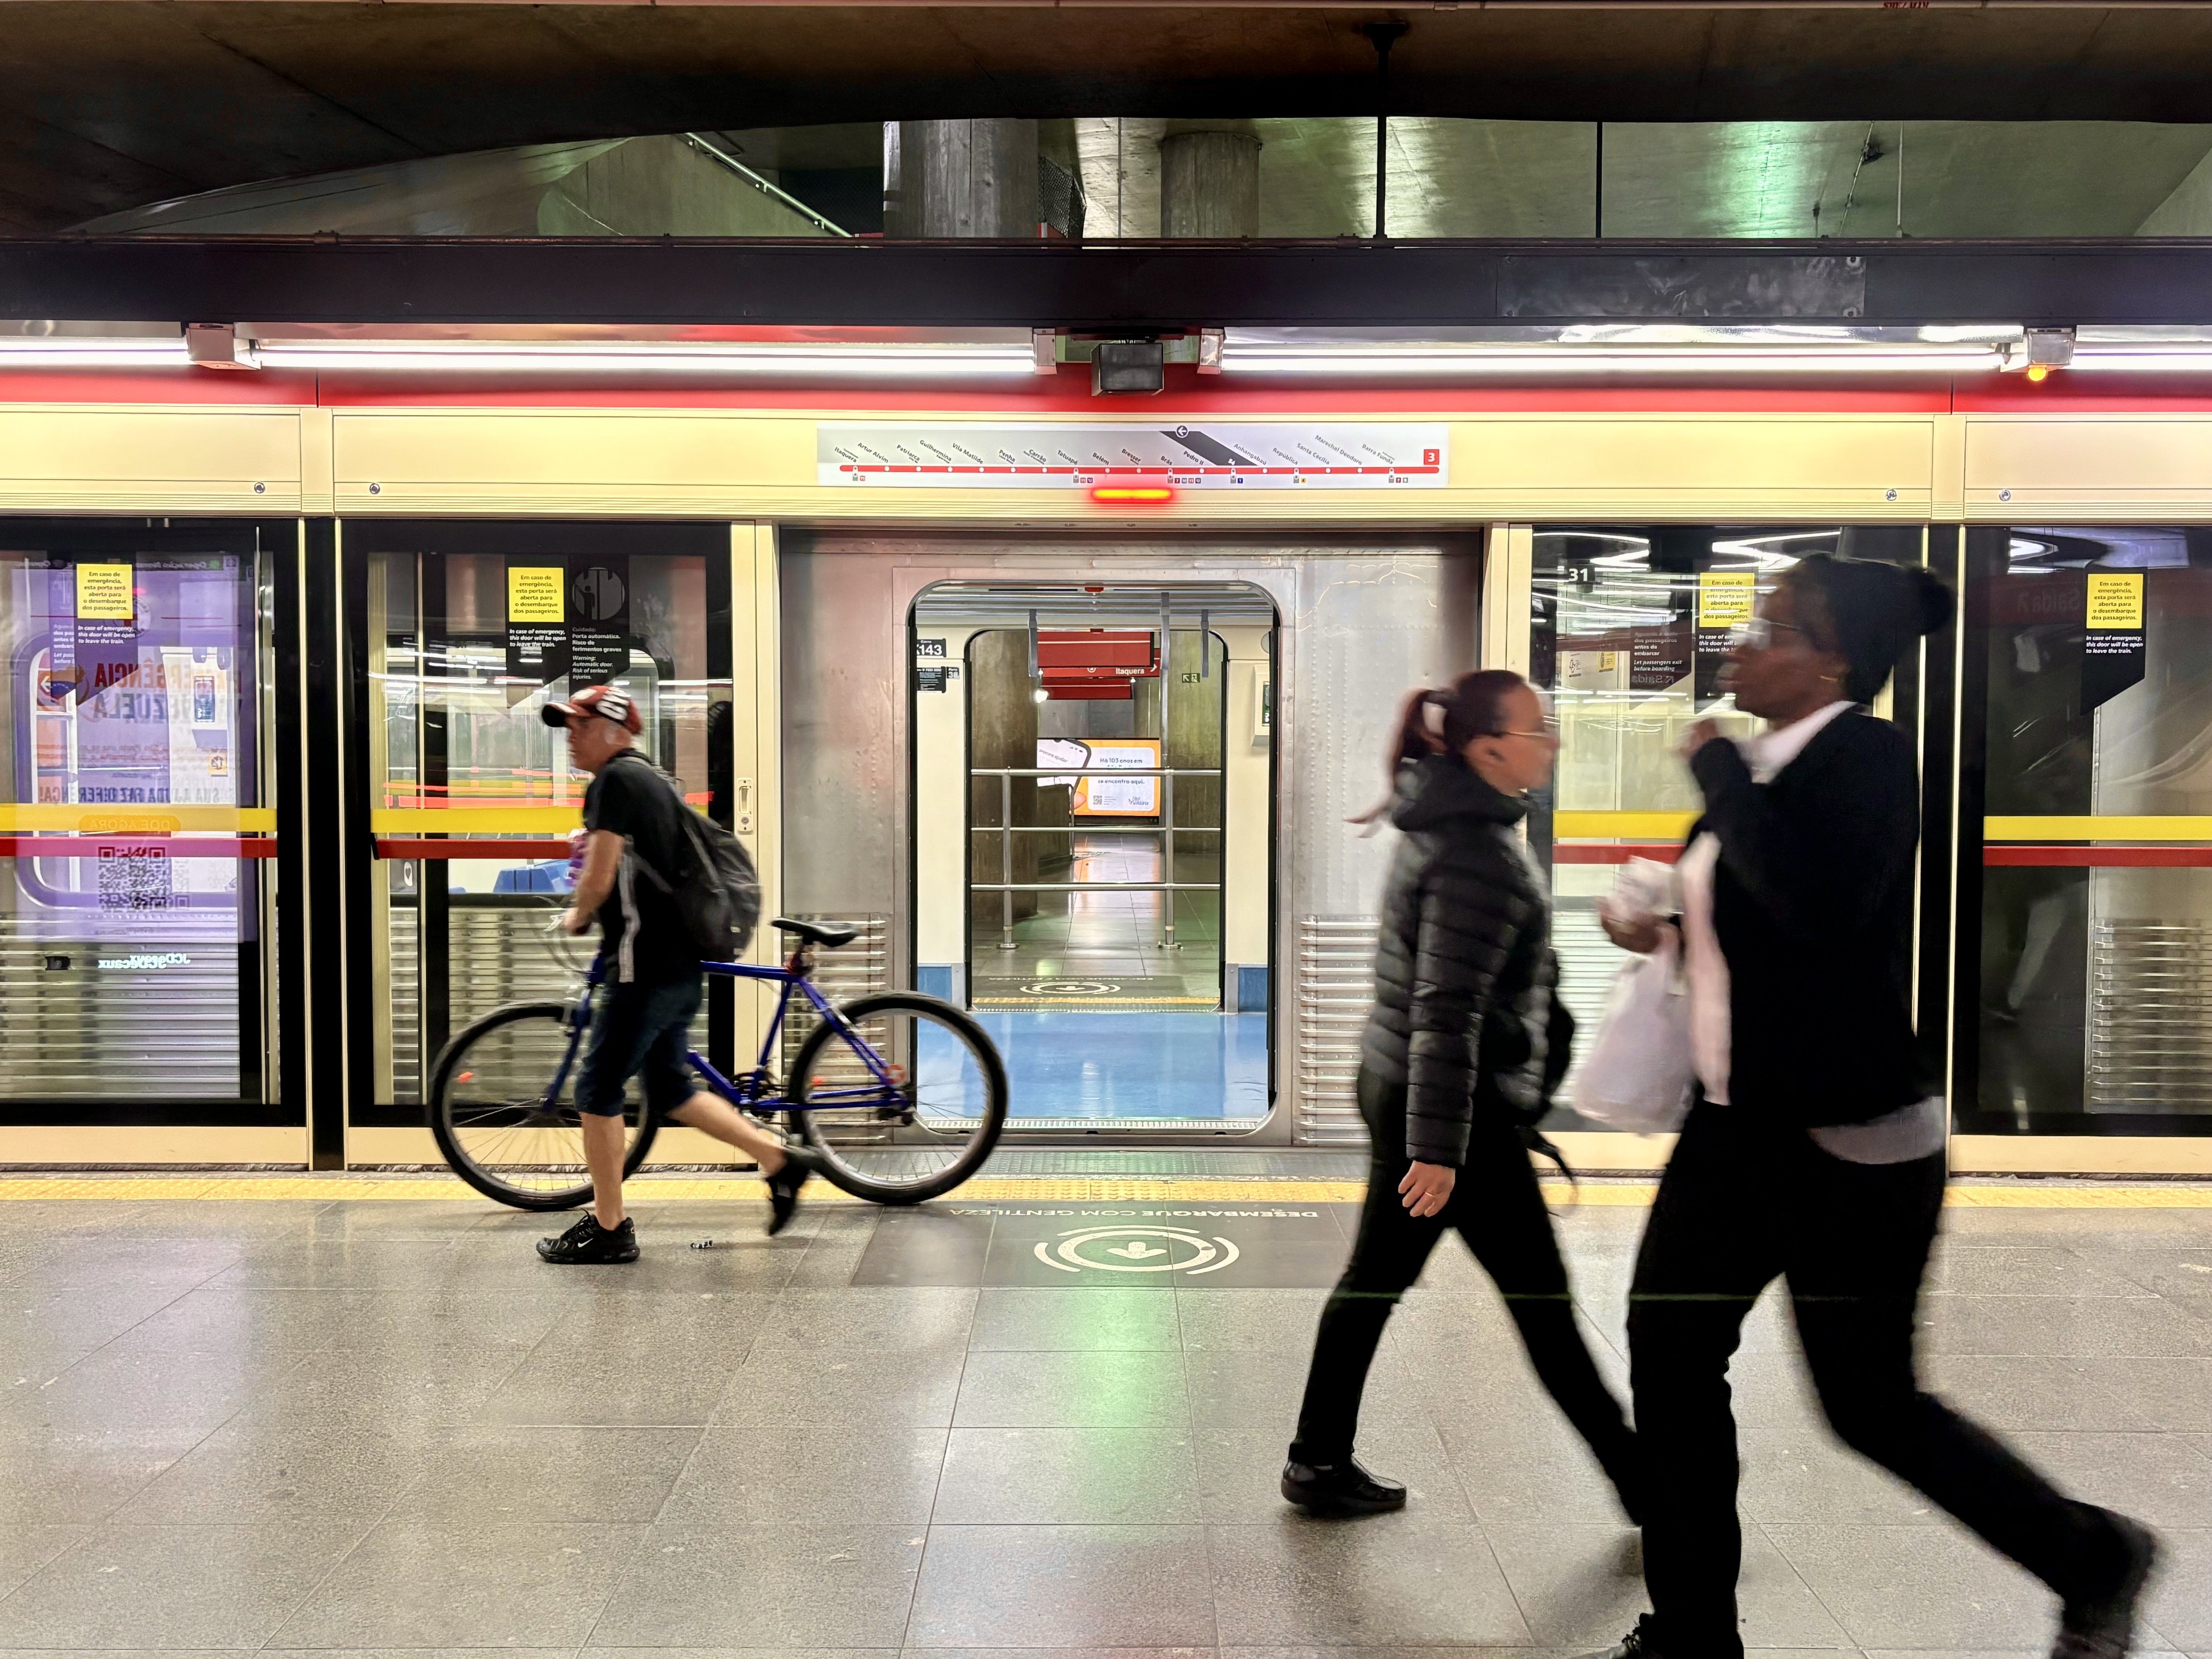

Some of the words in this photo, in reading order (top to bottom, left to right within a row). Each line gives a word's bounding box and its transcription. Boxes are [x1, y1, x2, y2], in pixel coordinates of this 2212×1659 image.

[835, 447, 857, 463] Itaquera
[858, 443, 872, 453] Artur
[872, 452, 888, 463] Alvim
[897, 445, 920, 461] Patriarca
[920, 440, 951, 461] Guilhermina
[953, 443, 962, 452] Vila
[963, 449, 983, 464] Matilde
[999, 449, 1015, 462] Penha
[1029, 449, 1046, 462] Carrão
[1058, 450, 1078, 465] Tatuapé
[1122, 448, 1141, 463] Bresser
[1184, 451, 1199, 462] Pedro
[1233, 443, 1267, 465] Anhangabaú
[1273, 448, 1298, 465] República
[1297, 443, 1311, 455] Santa
[1313, 452, 1329, 465] Cecília
[1316, 435, 1339, 452] Marechal
[1340, 449, 1362, 465] Deodoro
[1362, 444, 1375, 455] Barra
[1377, 452, 1393, 464] Funda
[1427, 452, 1435, 462] 3
[1092, 452, 1109, 465] Belém
[1161, 456, 1173, 465] Brás
[1569, 568, 1588, 581] 31
[1116, 668, 1144, 676] Itaquera
